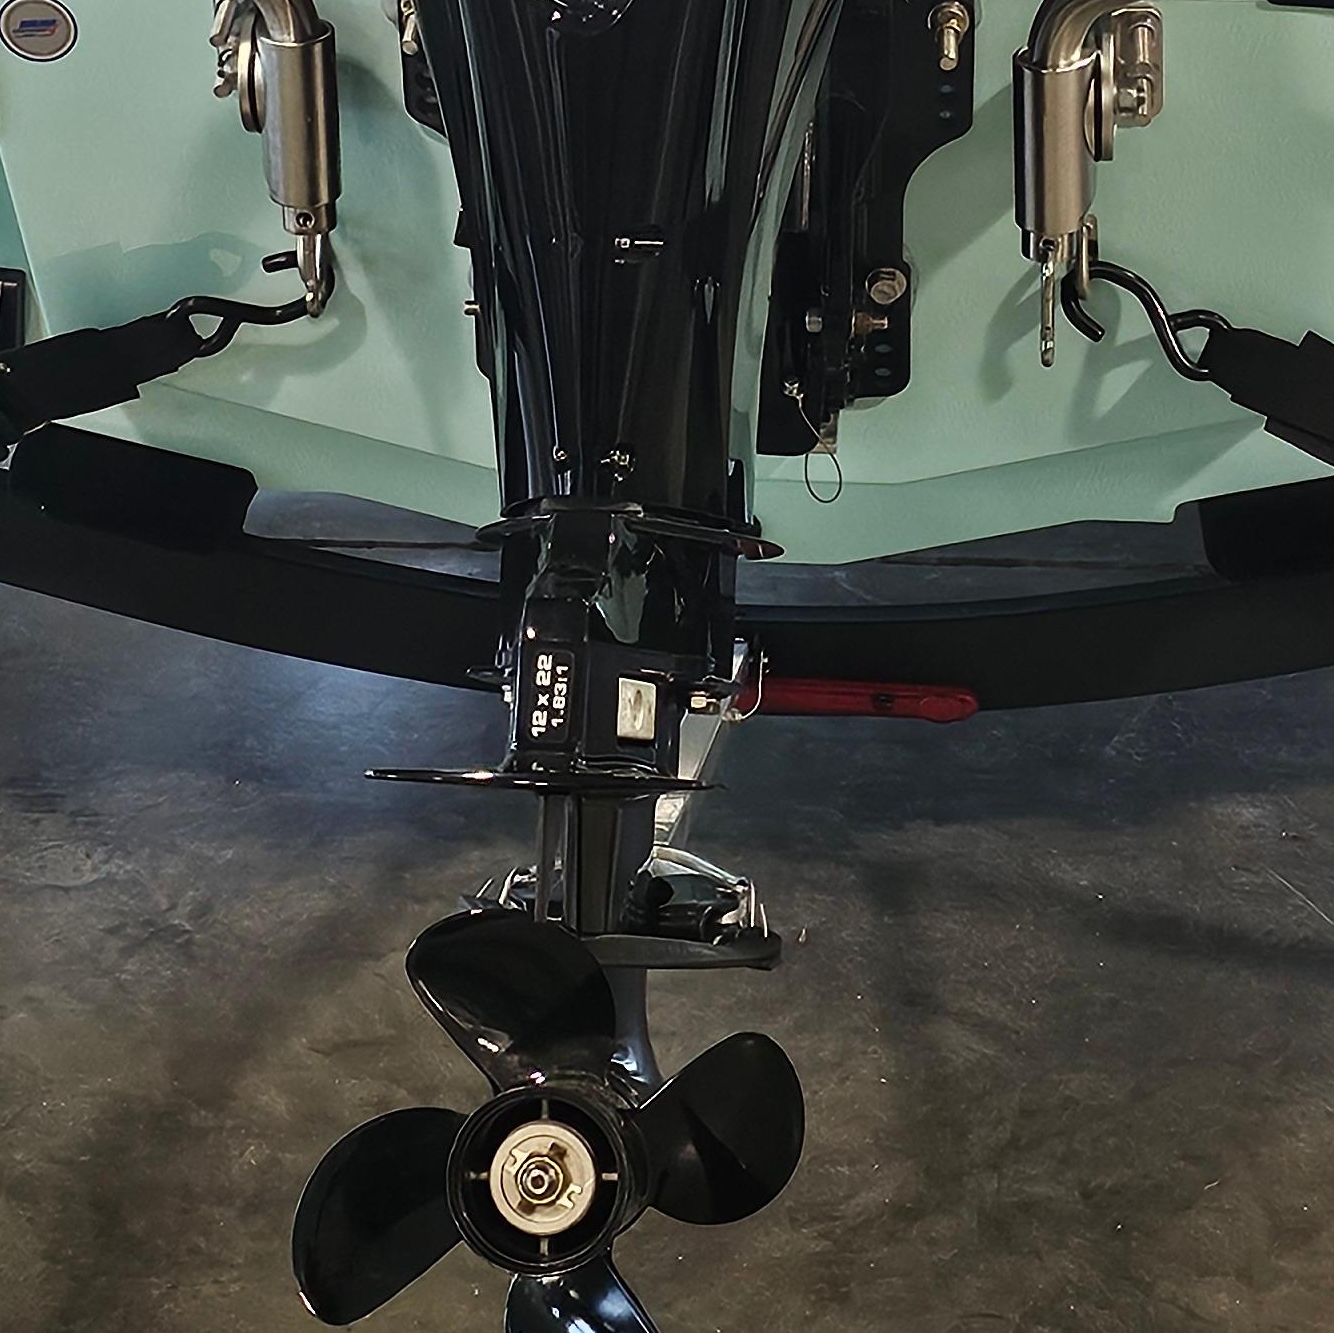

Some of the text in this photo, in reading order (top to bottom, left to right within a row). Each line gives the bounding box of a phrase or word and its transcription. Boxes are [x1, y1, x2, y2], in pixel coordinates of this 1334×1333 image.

[536, 654, 553, 686] 22
[551, 666, 569, 727] 1.83:1
[531, 710, 548, 737] 12
